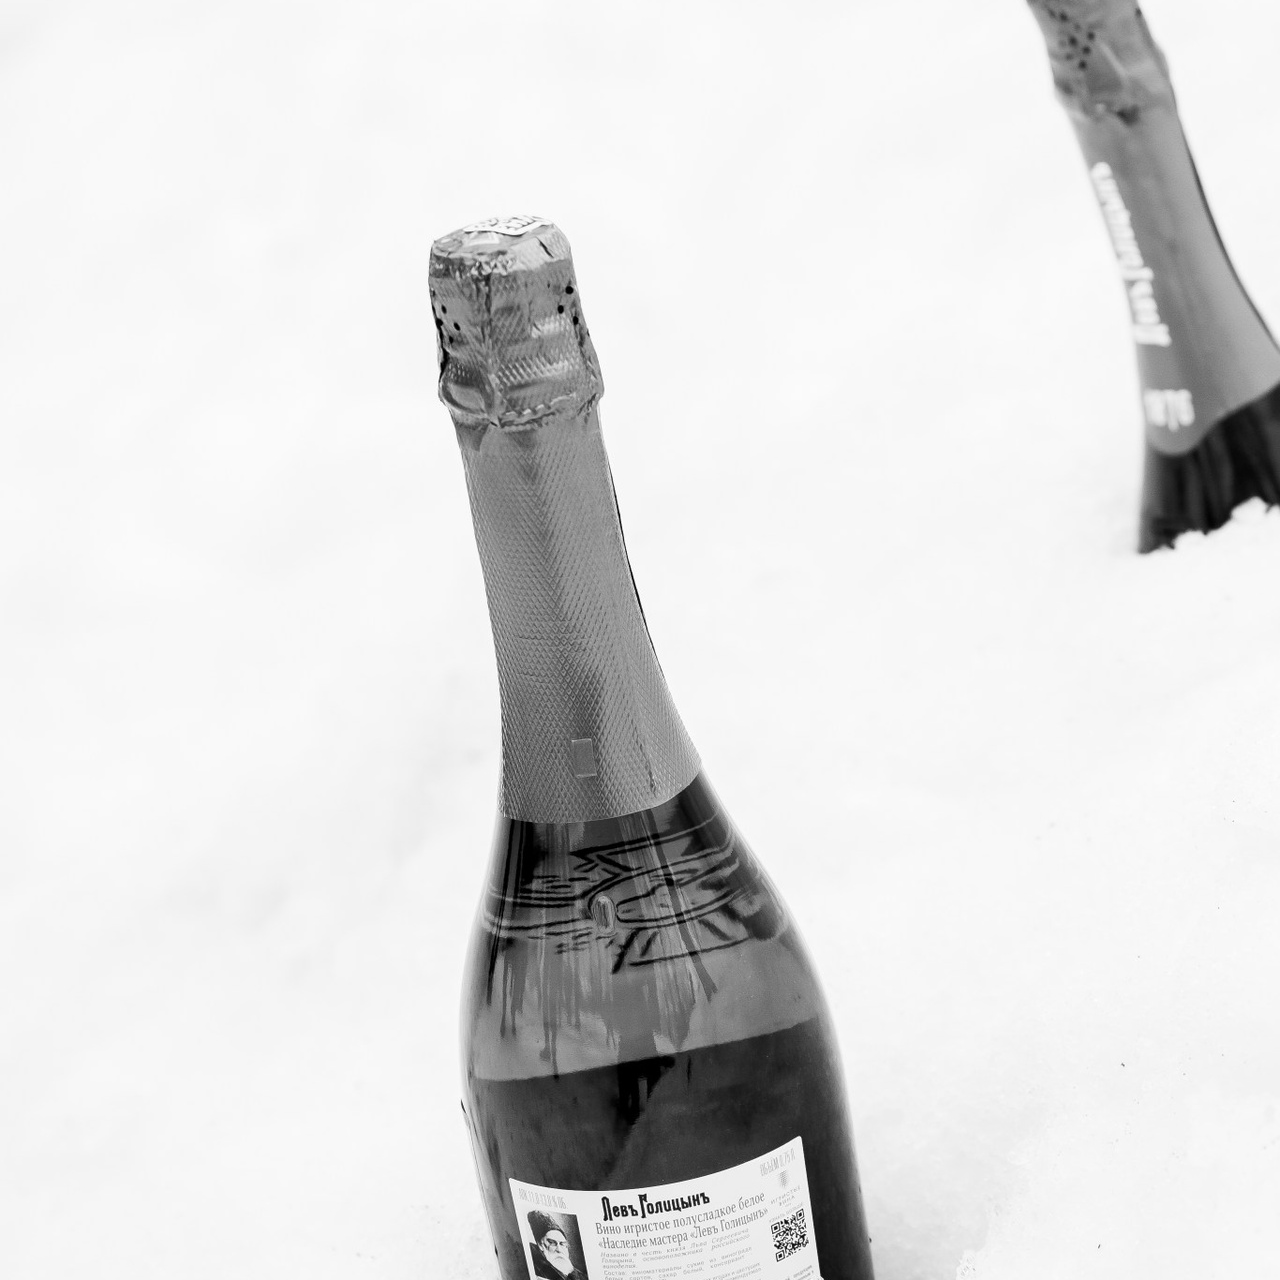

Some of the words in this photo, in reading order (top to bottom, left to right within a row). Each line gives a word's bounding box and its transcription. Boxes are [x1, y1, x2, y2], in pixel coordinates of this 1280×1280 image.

[595, 1222, 621, 1235] Вино
[624, 1220, 670, 1237] игристое
[673, 1203, 736, 1228] полусладкое
[738, 1192, 765, 1210] белое
[601, 1196, 638, 1221] Левъ
[638, 1192, 710, 1218] Голицынъ
[598, 1237, 649, 1249] «Наследие
[649, 1232, 688, 1247] мастера
[690, 1224, 718, 1239] «Левъ
